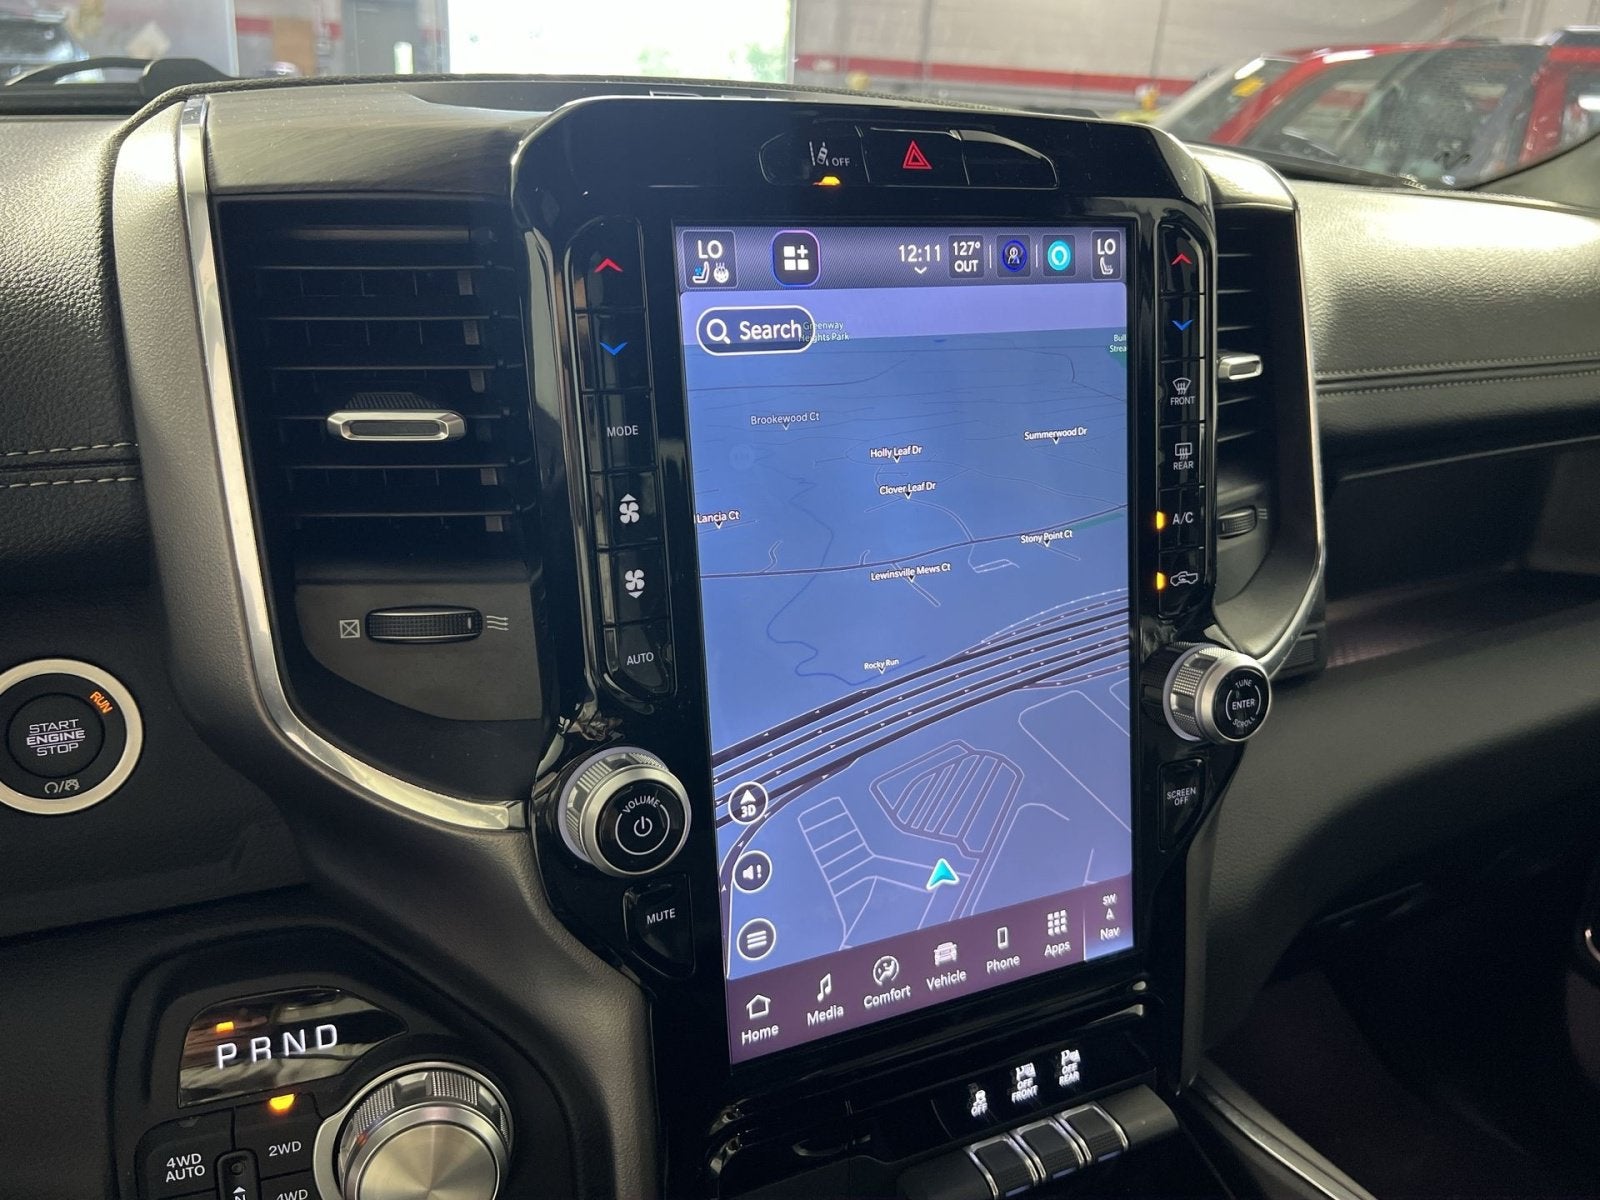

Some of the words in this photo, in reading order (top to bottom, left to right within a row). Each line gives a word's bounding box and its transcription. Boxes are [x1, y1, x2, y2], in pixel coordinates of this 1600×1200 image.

[831, 157, 851, 168] OFF
[697, 239, 723, 259] LO
[898, 244, 942, 263] 12:11
[952, 241, 981, 256] 127°
[1097, 238, 1116, 256] LO
[954, 259, 979, 273] OUT
[739, 319, 802, 341] Search
[802, 321, 844, 331] Greenway
[831, 332, 850, 341] Park
[1170, 395, 1196, 406] FRONT
[750, 412, 807, 426] Brookewood
[809, 411, 820, 421] Ct
[606, 425, 639, 437] MODE
[1024, 429, 1076, 441] Summerwood
[1077, 427, 1088, 437] Dr
[870, 447, 893, 460] Holly
[893, 447, 911, 457] Leaf
[911, 445, 923, 456] Dr
[1173, 460, 1194, 471] REAR
[879, 485, 906, 495] Clover
[907, 483, 924, 493] Leaf
[924, 481, 936, 491] Dr
[696, 511, 727, 524] Lancia
[728, 510, 740, 520] Ct
[1172, 511, 1194, 525] A/C
[1021, 533, 1042, 544] Stony
[1042, 531, 1063, 541] Point
[1063, 529, 1073, 539] Ct
[870, 568, 915, 581] Lewinsville
[915, 565, 940, 576] Mews
[941, 563, 951, 573] Ct
[626, 652, 655, 666] AUTO
[864, 662, 883, 674] Rocky
[883, 658, 900, 668] Run
[1235, 679, 1253, 689] TUNE
[89, 691, 113, 714] RUN
[1231, 698, 1256, 711] ENTER
[29, 718, 79, 734] START
[1232, 716, 1256, 728] SCROLL
[26, 730, 86, 746] ENGINE
[36, 742, 79, 757] STOP
[1166, 787, 1197, 800] SCREEN
[1174, 796, 1189, 806] OFF
[622, 795, 661, 814] VOLUME
[741, 804, 757, 818] 3D
[646, 908, 676, 925] MUTE
[1100, 926, 1120, 940] Nav
[1044, 940, 1070, 958] Apps
[986, 953, 1021, 975] Phone
[926, 969, 967, 991] Vehicle
[863, 984, 911, 1009] Comfort
[806, 1004, 844, 1027] Media
[741, 1024, 779, 1046] Home
[1062, 1062, 1078, 1076] OFF
[1017, 1077, 1034, 1091] OFF
[1011, 1084, 1039, 1104] FRONT
[971, 1102, 988, 1118] OFF
[268, 1140, 302, 1157] 2WD
[166, 1153, 202, 1168] 4WD
[165, 1164, 206, 1183] AUTO
